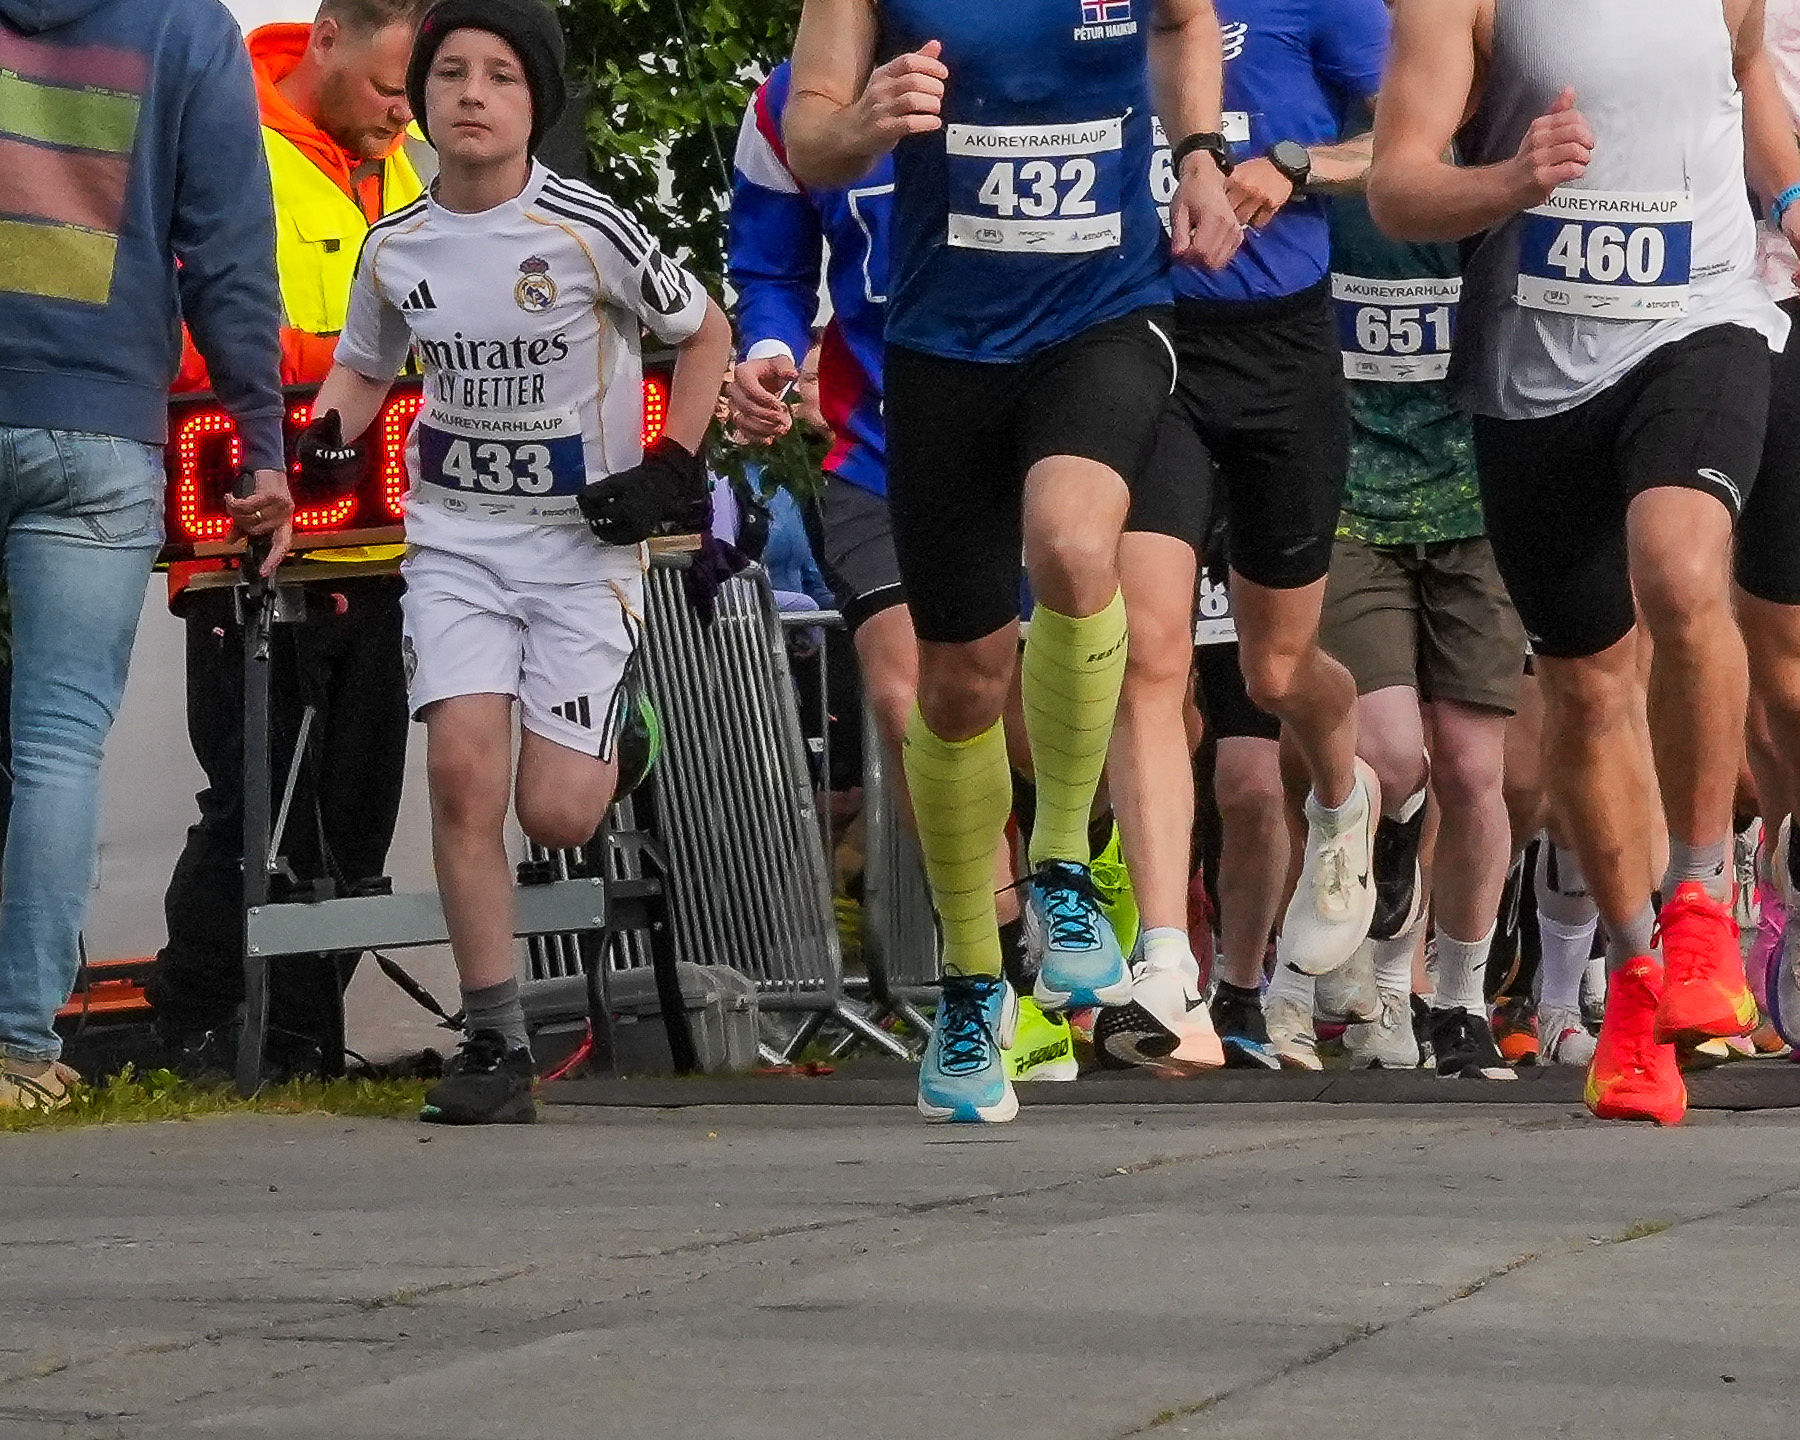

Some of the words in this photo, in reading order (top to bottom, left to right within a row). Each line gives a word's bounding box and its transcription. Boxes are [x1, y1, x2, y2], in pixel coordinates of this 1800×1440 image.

[965, 129, 1107, 148] AKUREYRARHLAUP
[978, 158, 1096, 218] 432
[1547, 223, 1666, 284] 460
[1344, 283, 1460, 298] AKUREYRARHLAU
[1355, 306, 1450, 353] 651
[418, 331, 570, 371] mirates
[437, 374, 457, 404] LY
[463, 373, 546, 408] BETTER
[430, 408, 563, 433] AKUREYRARHLAUP
[442, 439, 554, 494] 433
